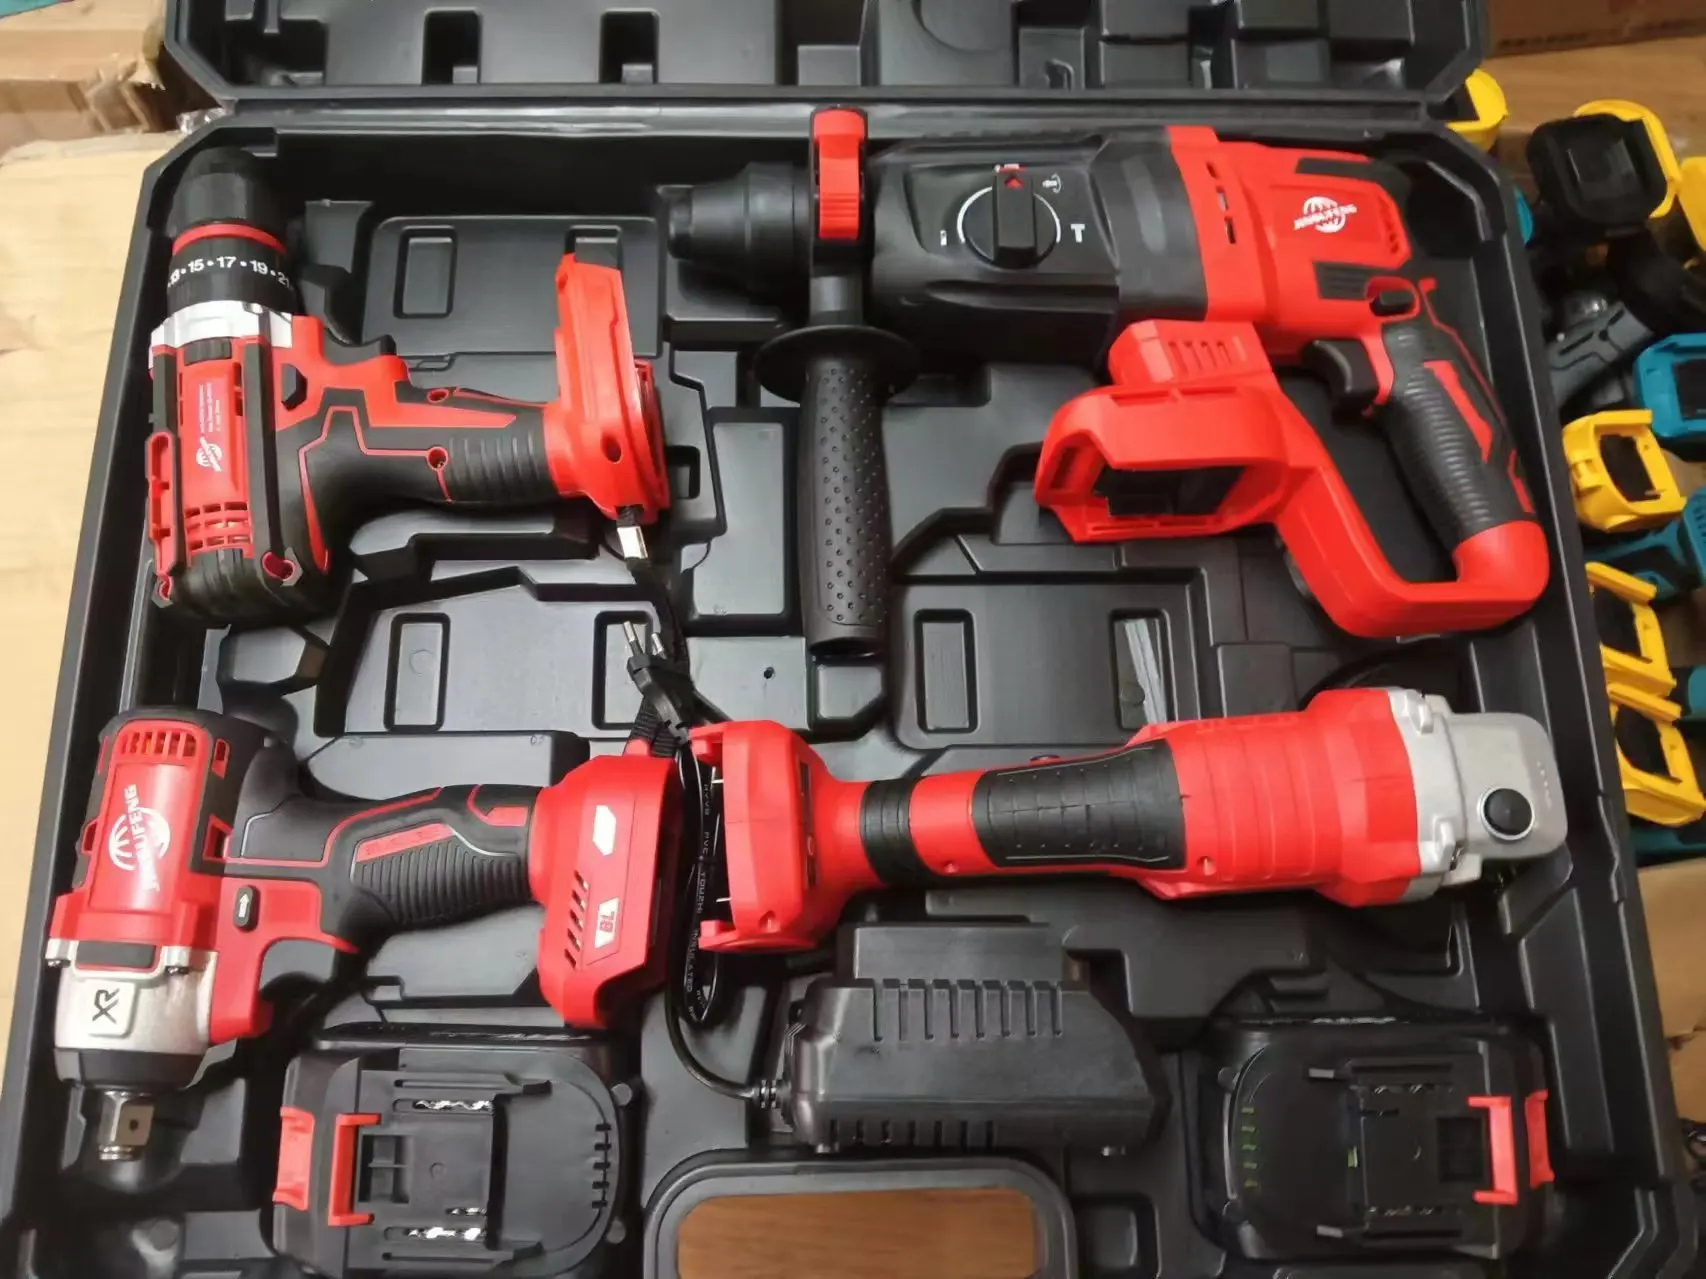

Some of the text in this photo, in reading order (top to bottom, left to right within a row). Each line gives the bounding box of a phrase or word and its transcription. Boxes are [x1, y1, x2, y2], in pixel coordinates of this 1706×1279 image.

[187, 258, 206, 274] 15
[215, 255, 238, 269] 17
[249, 260, 269, 275] 19
[599, 910, 615, 933] BL
[92, 987, 120, 1025] XR
